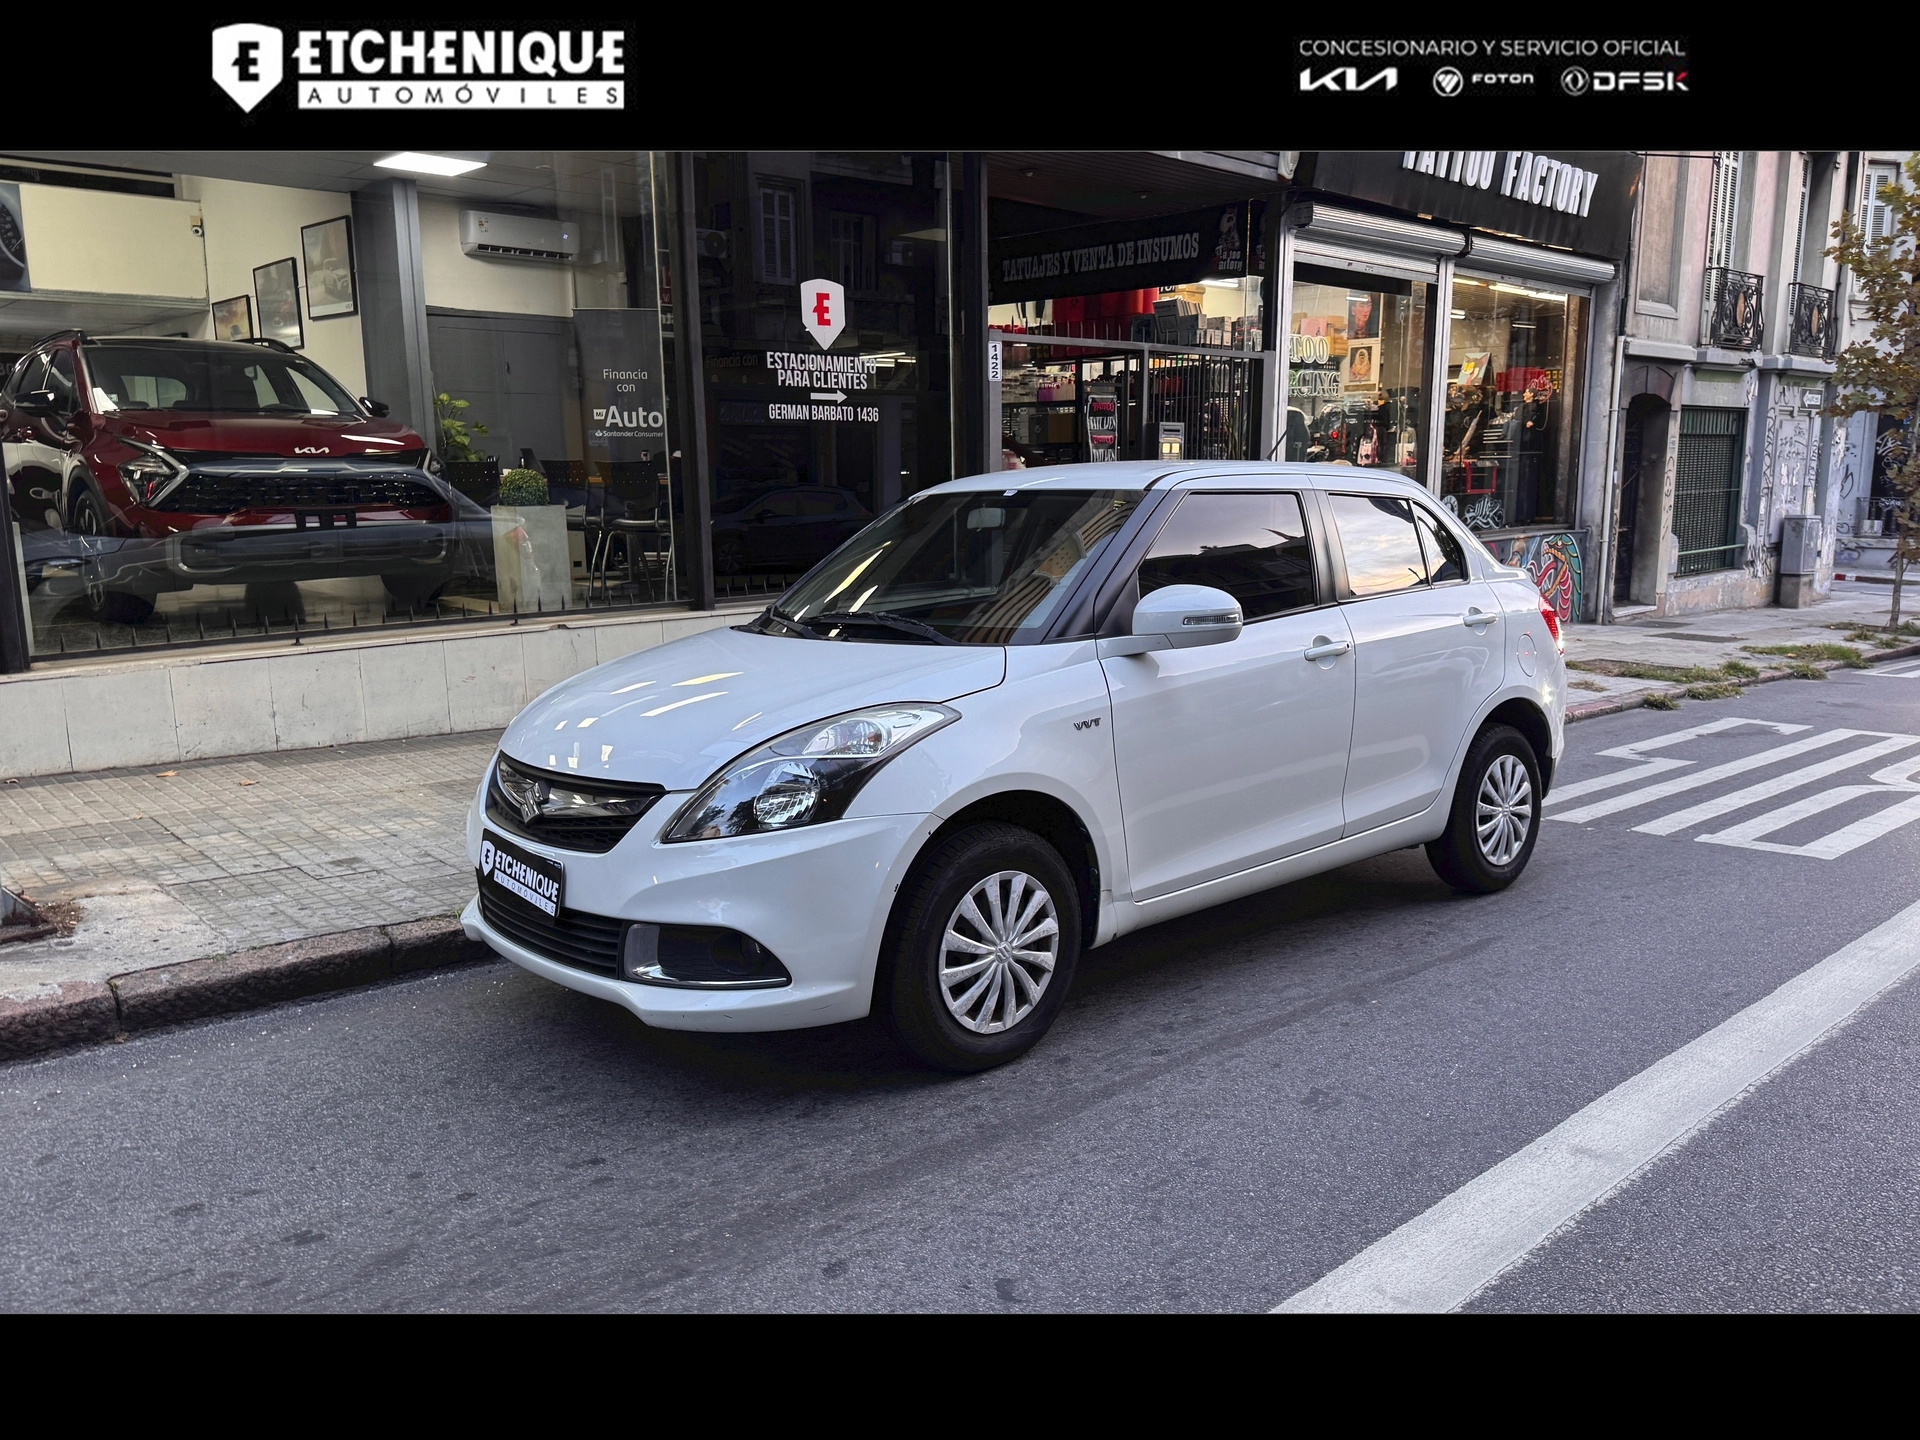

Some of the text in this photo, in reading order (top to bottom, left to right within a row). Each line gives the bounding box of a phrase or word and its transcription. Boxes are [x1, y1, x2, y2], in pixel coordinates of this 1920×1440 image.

[1500, 151, 1599, 217] FACTORY
[1002, 232, 1199, 282] TATUAJES Y VENTA DE INSUMOS
[766, 351, 877, 374] ESTACIONAMIENTO
[991, 344, 999, 379] 1422
[603, 369, 648, 380] Financia
[778, 369, 868, 390] PARA CLIENTES
[616, 384, 636, 392] con
[605, 405, 663, 428] Auto
[768, 404, 810, 420] GERMAN
[811, 405, 854, 421] BARBATO
[856, 407, 879, 422] 1436
[495, 850, 559, 902] ETCHENIQUE
